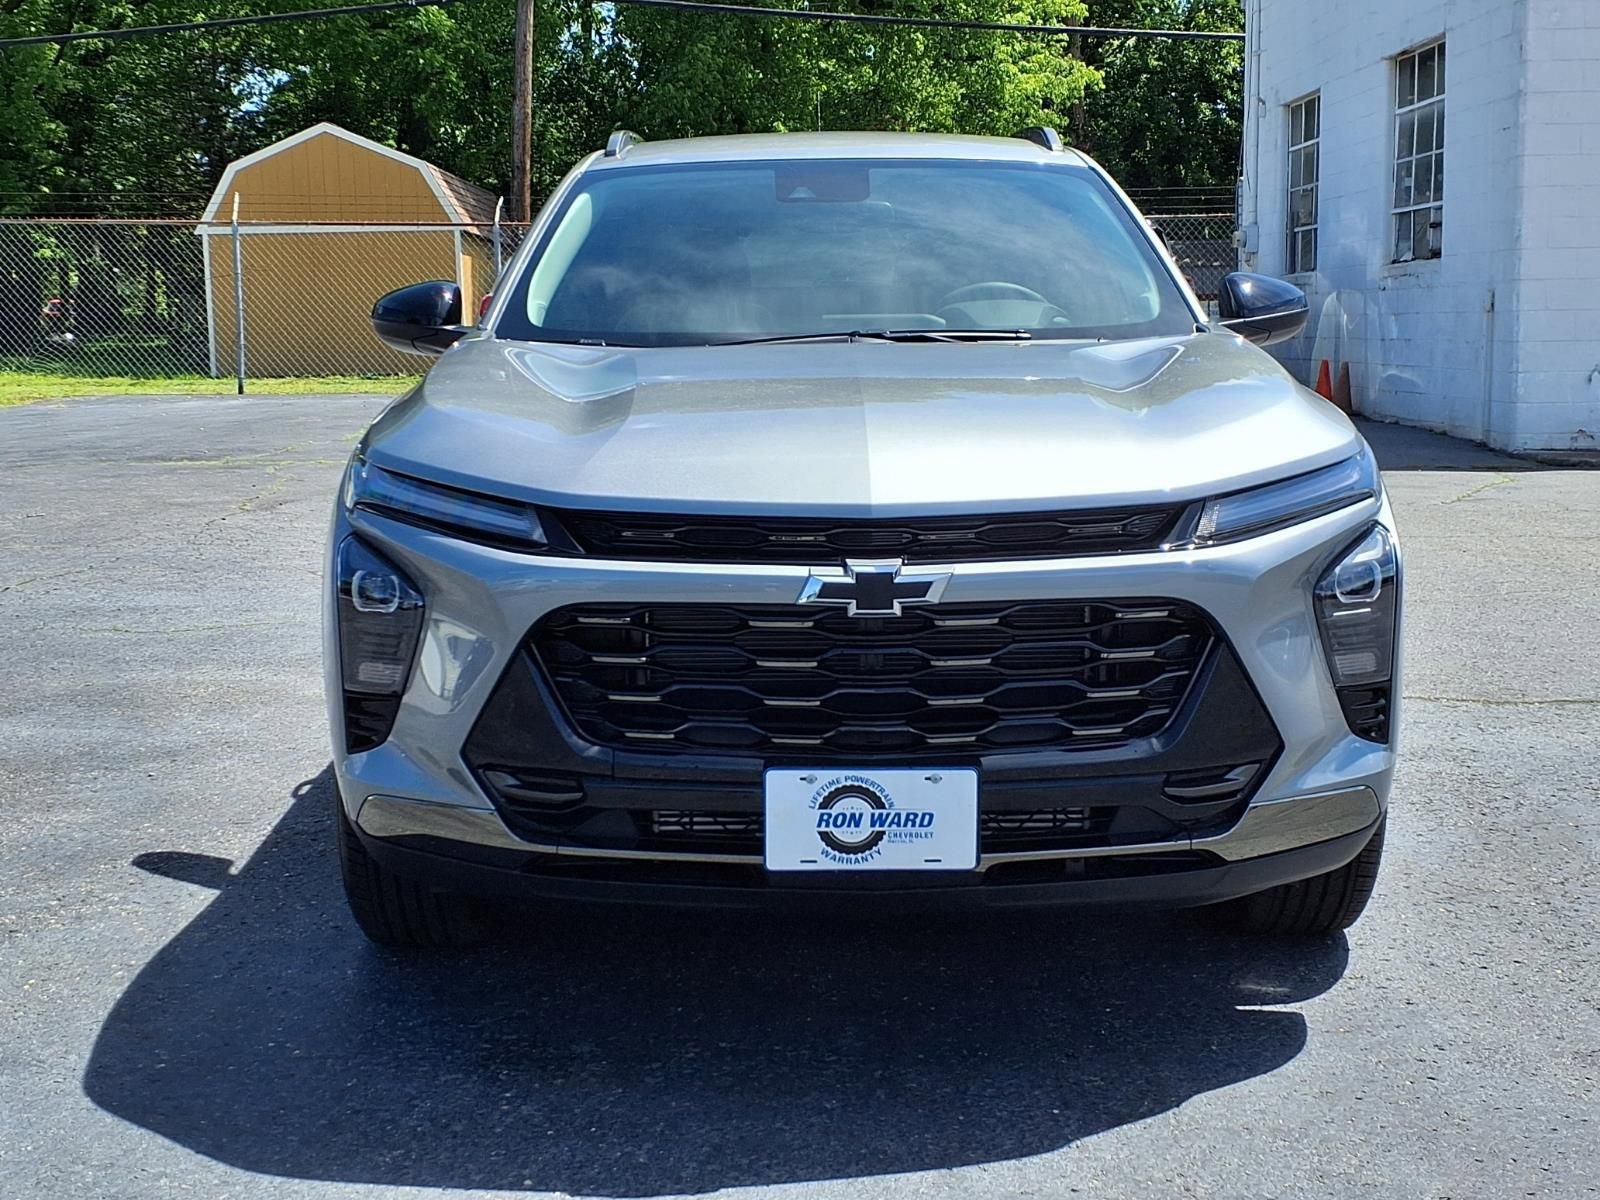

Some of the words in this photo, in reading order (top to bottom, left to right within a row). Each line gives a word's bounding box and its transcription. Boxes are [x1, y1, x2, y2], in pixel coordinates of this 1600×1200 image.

[816, 812, 864, 829] RON
[869, 812, 935, 828] WARD
[887, 831, 934, 839] CHEVROLET
[819, 848, 882, 865] WARRANTY
